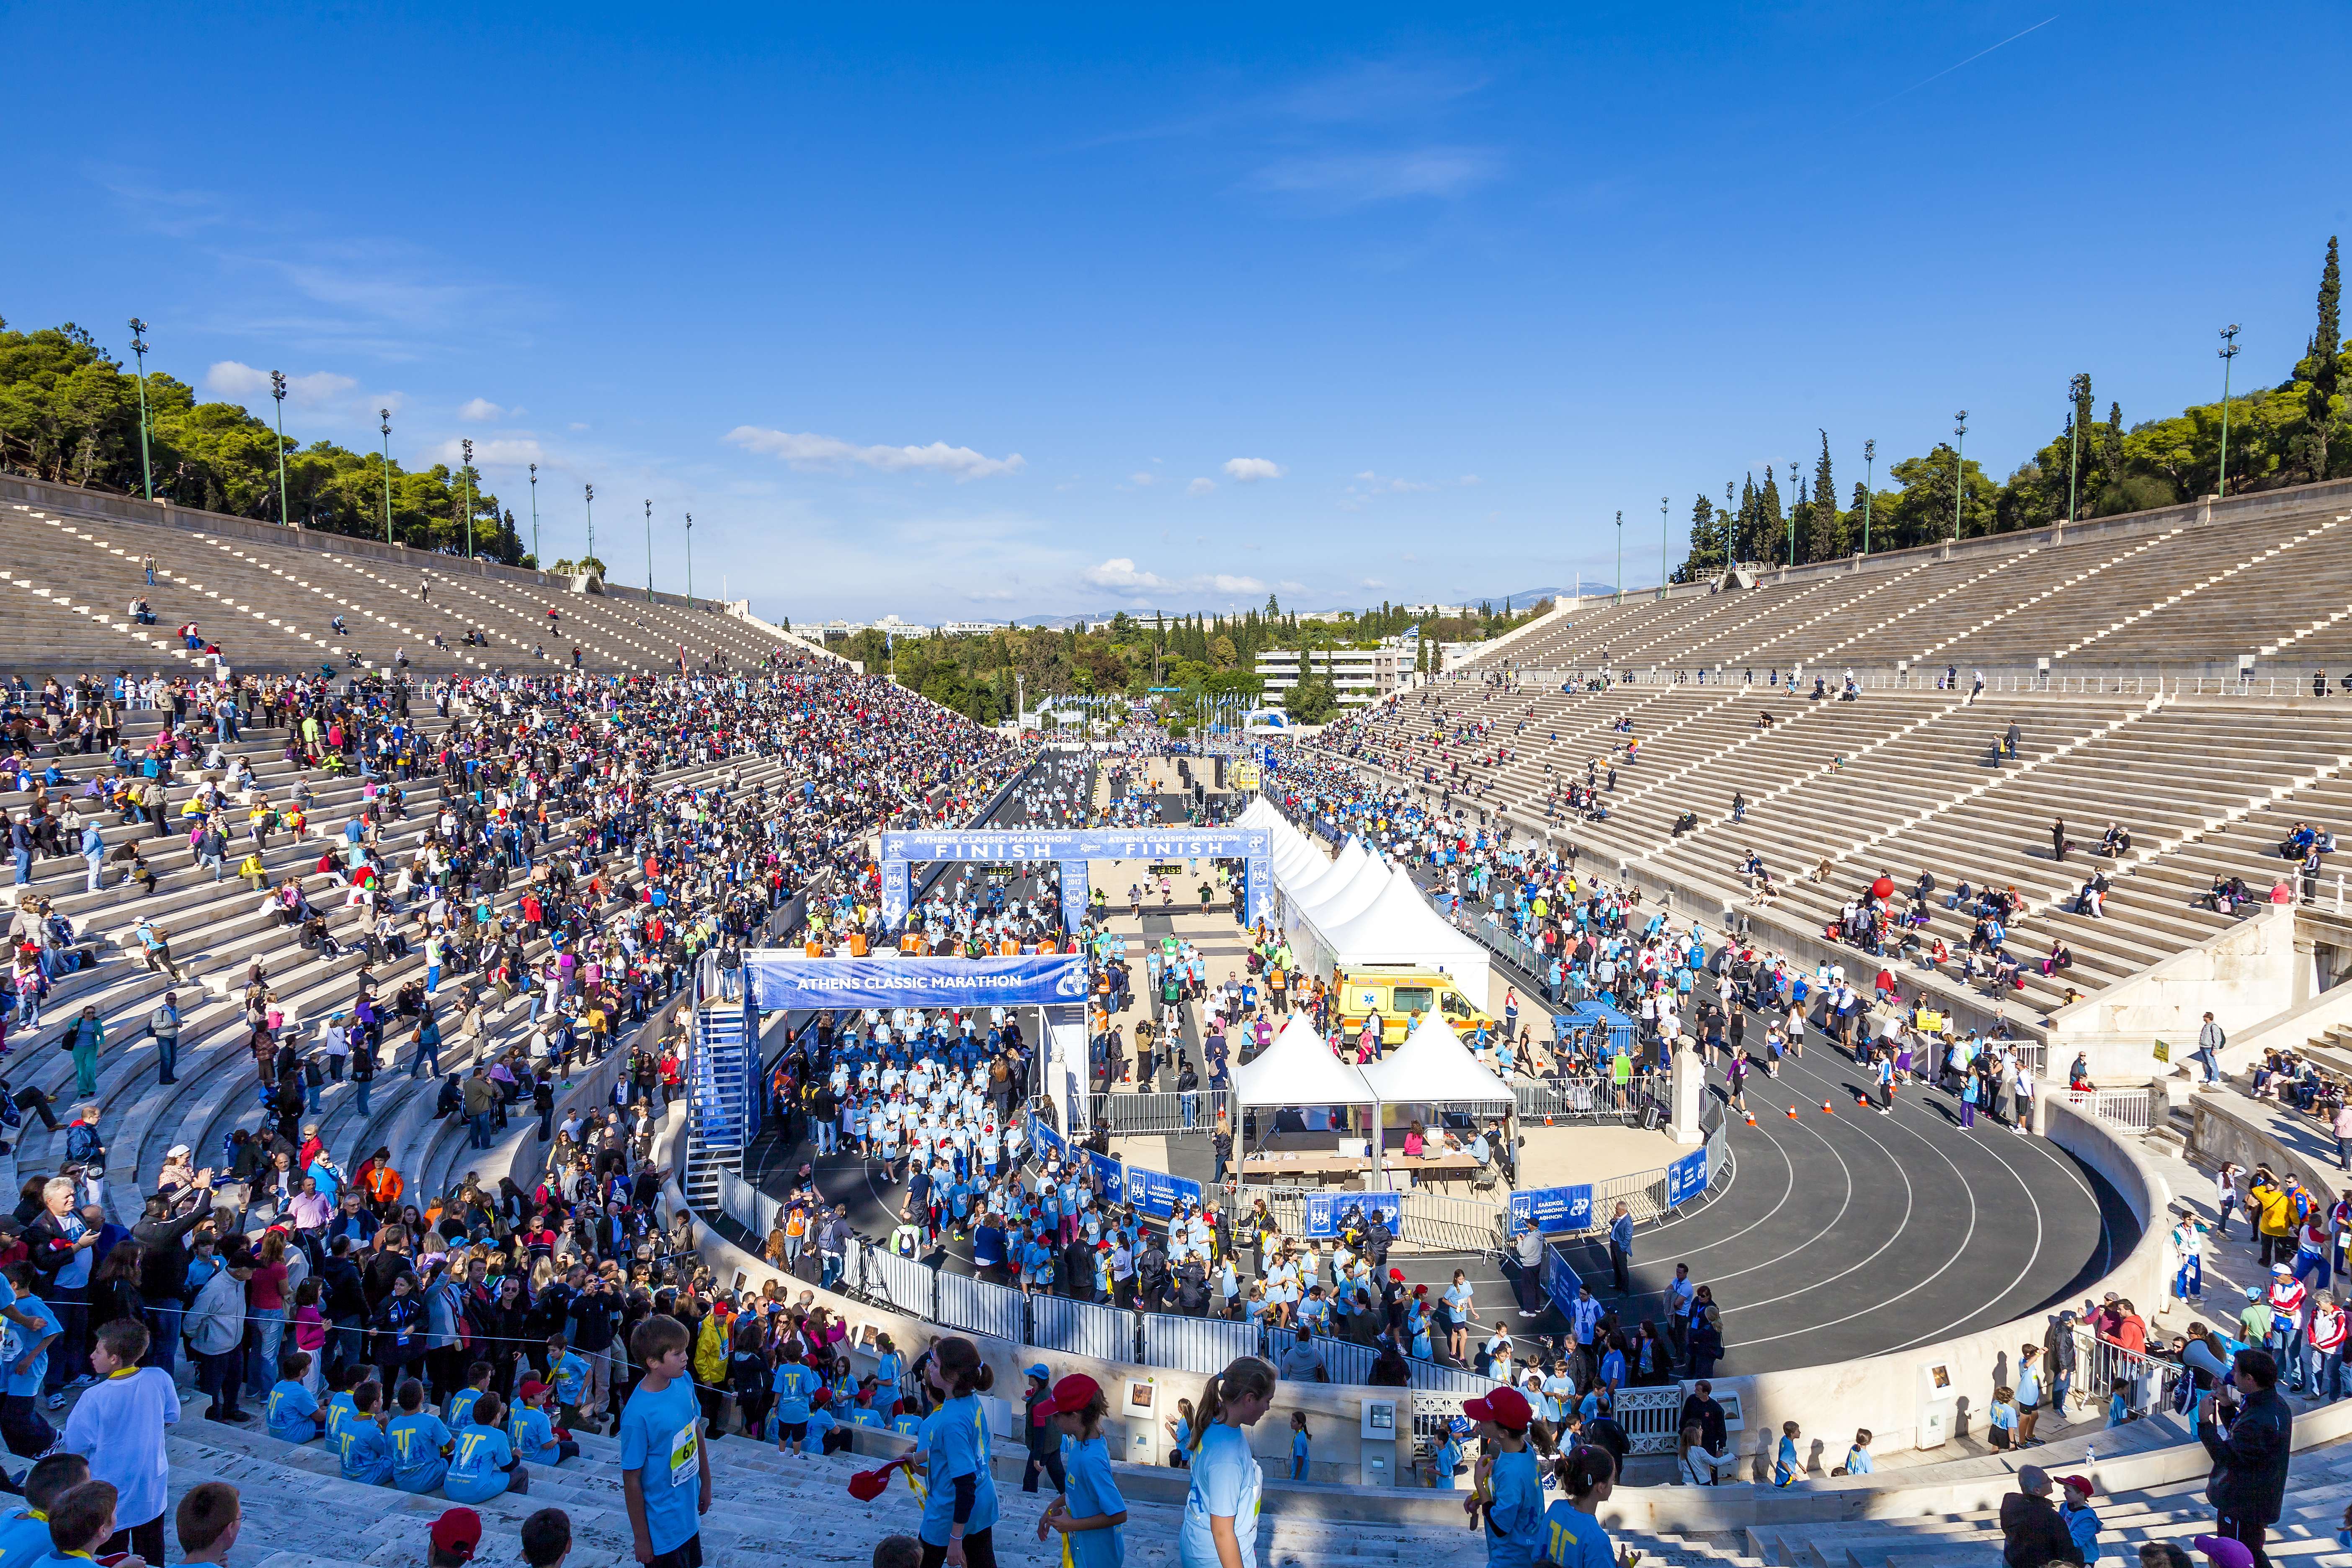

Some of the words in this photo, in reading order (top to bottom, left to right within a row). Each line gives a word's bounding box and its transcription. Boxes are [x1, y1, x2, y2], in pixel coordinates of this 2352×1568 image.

[936, 844, 1050, 858] FINISH
[1126, 843, 1222, 855] FINISH
[797, 977, 860, 990] ATHENS
[865, 976, 928, 989] CLASSIC
[932, 975, 1021, 988] MARATHON
[1151, 1184, 1174, 1194] ΚΛΑΣΙΚΟΣ
[1148, 1190, 1178, 1201] ΜΑΡΑΘΩΝΙΟ
[1153, 1198, 1173, 1207] ΑΘΗΝΩΝ
[1533, 1207, 1568, 1215] ΜΑΡΑΘΩΝΙΟΣ
